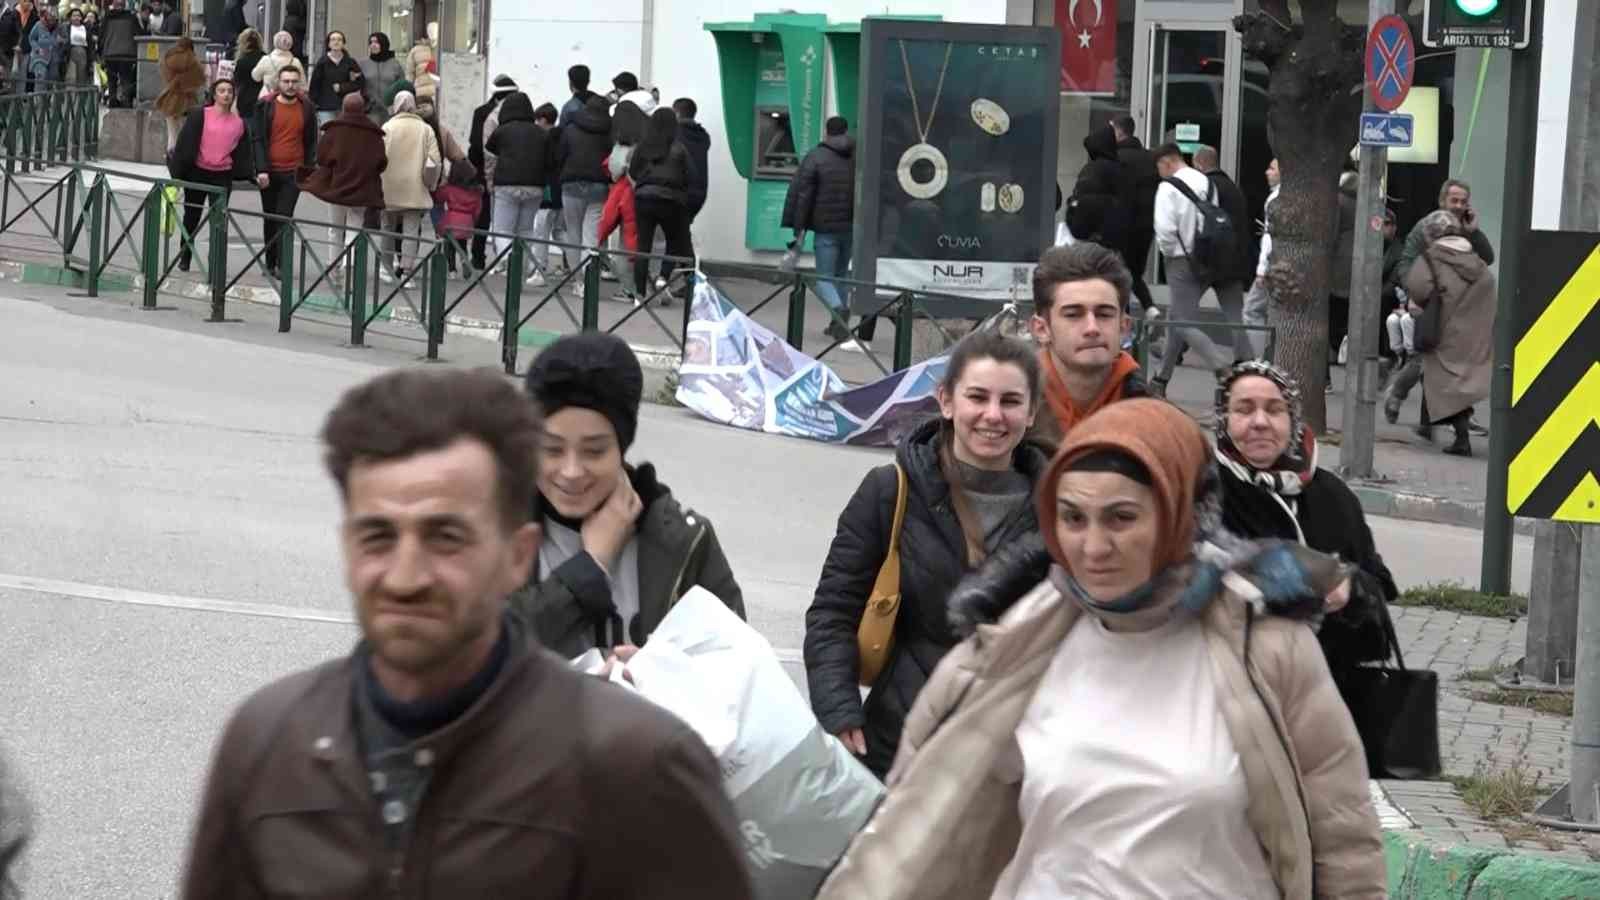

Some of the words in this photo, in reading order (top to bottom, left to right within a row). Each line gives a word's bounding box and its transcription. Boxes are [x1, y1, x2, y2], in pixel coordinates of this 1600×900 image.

[1443, 35, 1470, 46] ARIZA
[1473, 35, 1489, 46] TEL
[1493, 35, 1509, 46] 153
[933, 264, 984, 278] NUR
